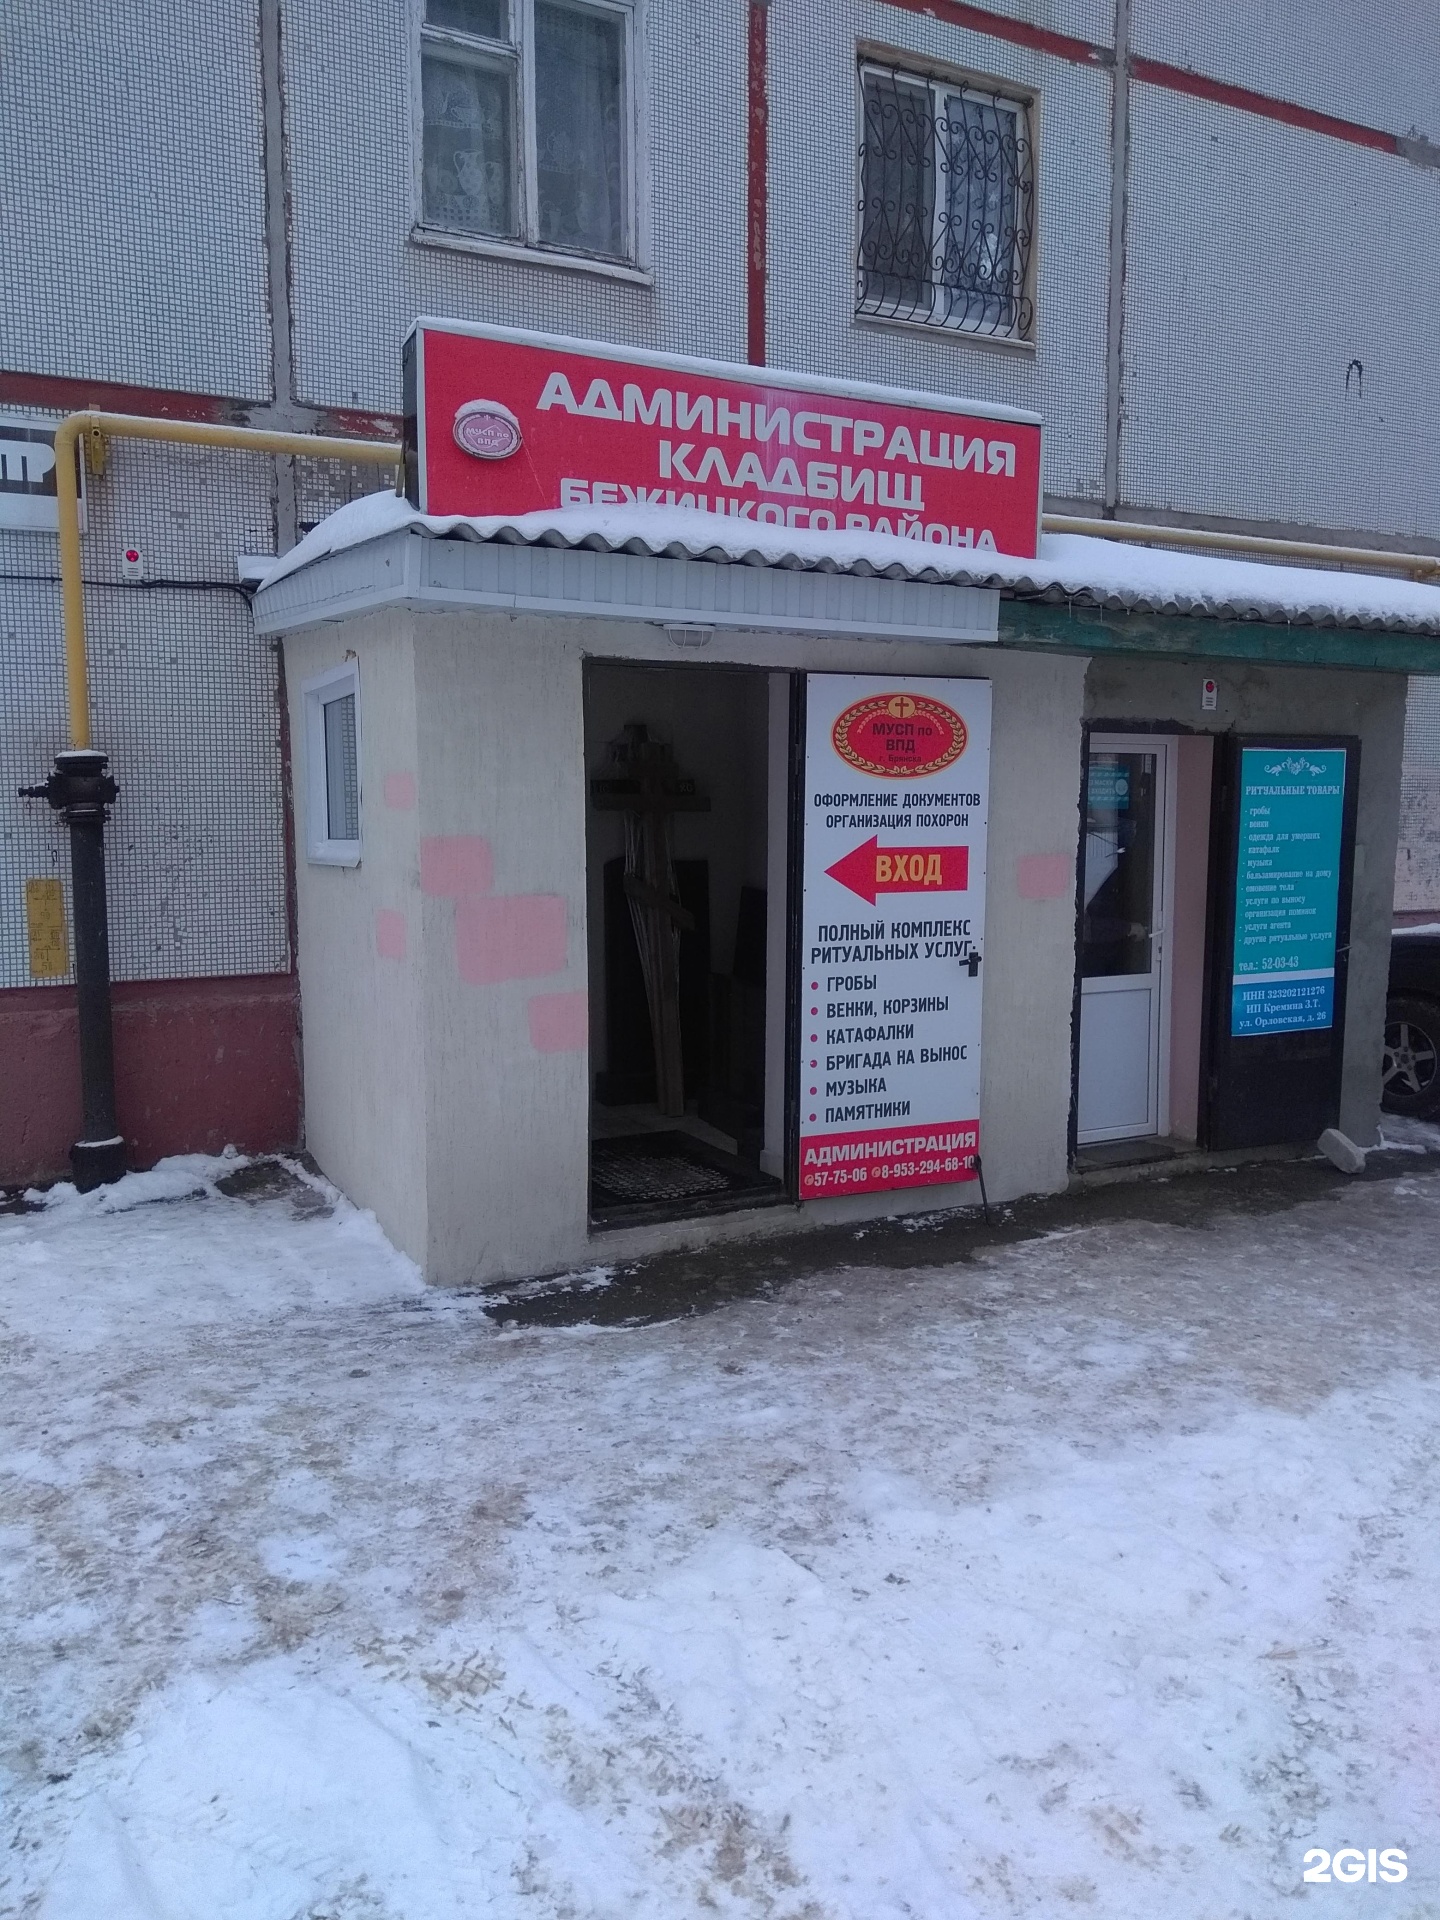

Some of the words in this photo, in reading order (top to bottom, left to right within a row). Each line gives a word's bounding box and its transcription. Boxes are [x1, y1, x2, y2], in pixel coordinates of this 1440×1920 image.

[536, 371, 1016, 478] АДМИНИСТРАЦИЯ
[659, 442, 925, 512] КЛАДБИЩ
[872, 723, 914, 736] МУСП
[917, 727, 932, 736] по
[885, 739, 916, 753] ВПД
[1246, 785, 1305, 795] РИТУАЛЬНЫЕ
[1307, 785, 1340, 795] ТОВАРЫ
[814, 793, 898, 808] ОФОРМЛЕНИЕ
[902, 793, 981, 810] ДОКУМЕНТОВ
[1249, 806, 1270, 816] гробы
[826, 813, 911, 829] ОРГАНИЗАЦИЯ
[916, 813, 969, 827] ПОХОРОН
[1248, 833, 1273, 841] одежда
[1276, 833, 1289, 841] для
[1291, 832, 1320, 841] умерших
[1248, 845, 1280, 855] катафалк
[876, 854, 942, 885] ВХОД
[1247, 859, 1272, 868] музыка
[1246, 870, 1303, 880] бальзамирование
[1315, 870, 1332, 879] дому
[1245, 885, 1277, 893] омовение
[1245, 898, 1269, 907] услуги
[1281, 896, 1306, 904] выносу
[1244, 909, 1286, 919] организация
[1288, 908, 1317, 916] поминок
[818, 920, 885, 942] ПОЛНЫЙ
[891, 919, 971, 939] КОМПЛЕКС
[1244, 922, 1268, 933] услуги
[1269, 922, 1291, 930] агента
[1243, 935, 1267, 945] другие
[1269, 933, 1308, 944] ритуальные
[1310, 931, 1332, 941] услуги
[811, 941, 919, 965] РИТУАЛЬНЫХ
[1239, 961, 1259, 972] тел.:
[1262, 955, 1299, 970] 52-03-43
[827, 975, 877, 992] ГРОБЫ
[1243, 990, 1265, 1001] ИНН
[1267, 986, 1325, 999] 323202121276
[826, 1001, 878, 1019] ВЕНКИ,
[883, 996, 949, 1015] КОРЗИНЫ
[1246, 1004, 1261, 1014] ИП
[1263, 1002, 1304, 1014] Кремина
[1239, 1020, 1253, 1030] ул.
[1254, 1015, 1305, 1028] Орловская,
[1316, 1011, 1327, 1020] 26
[826, 1024, 914, 1045] КАТАФАЛКИ
[826, 1051, 892, 1071] БРИГАДА
[897, 1049, 915, 1065] НА
[920, 1045, 968, 1063] ВЫНОС
[826, 1077, 887, 1097] МУЗЫКА
[825, 1100, 911, 1123] ПАМЯТНИКИ
[804, 1132, 976, 1167] АДМИНИСТРАЦИЯ
[814, 1168, 867, 1186] 57-75-06
